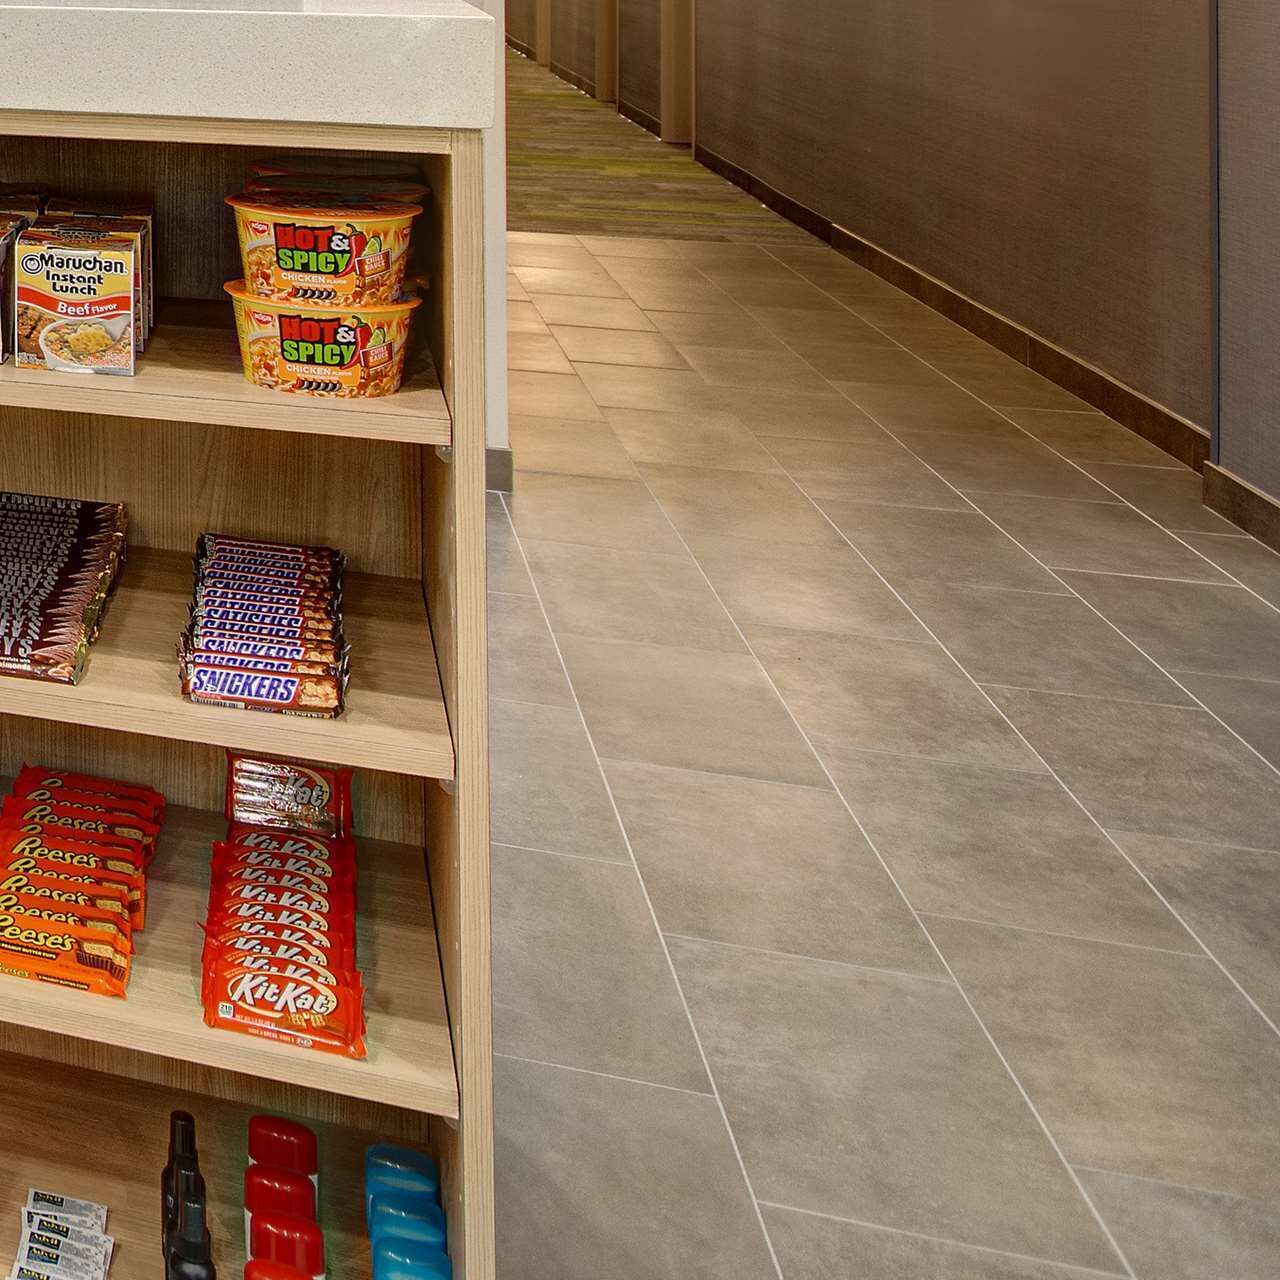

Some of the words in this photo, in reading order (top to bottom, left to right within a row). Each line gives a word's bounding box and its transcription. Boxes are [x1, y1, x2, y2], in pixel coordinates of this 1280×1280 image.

[275, 224, 334, 251] HOT
[331, 235, 351, 251] &
[39, 254, 125, 274] Maruchan
[278, 248, 351, 273] SPICY
[45, 271, 104, 285] Instant
[52, 282, 97, 296] Lunch
[281, 272, 326, 284] CHICKEN
[57, 301, 90, 315] Beef
[91, 302, 117, 313] Flavor
[280, 316, 339, 344] HOT
[336, 326, 356, 343] &
[282, 340, 356, 365] SPICY
[286, 363, 331, 376] CHICKEN
[192, 668, 299, 702] SNICKERS
[11, 836, 101, 870] Reese's
[22, 947, 42, 956] BUTTER
[42, 951, 57, 959] CUPS
[230, 972, 280, 1006] Kit
[273, 981, 330, 1014] Kat
